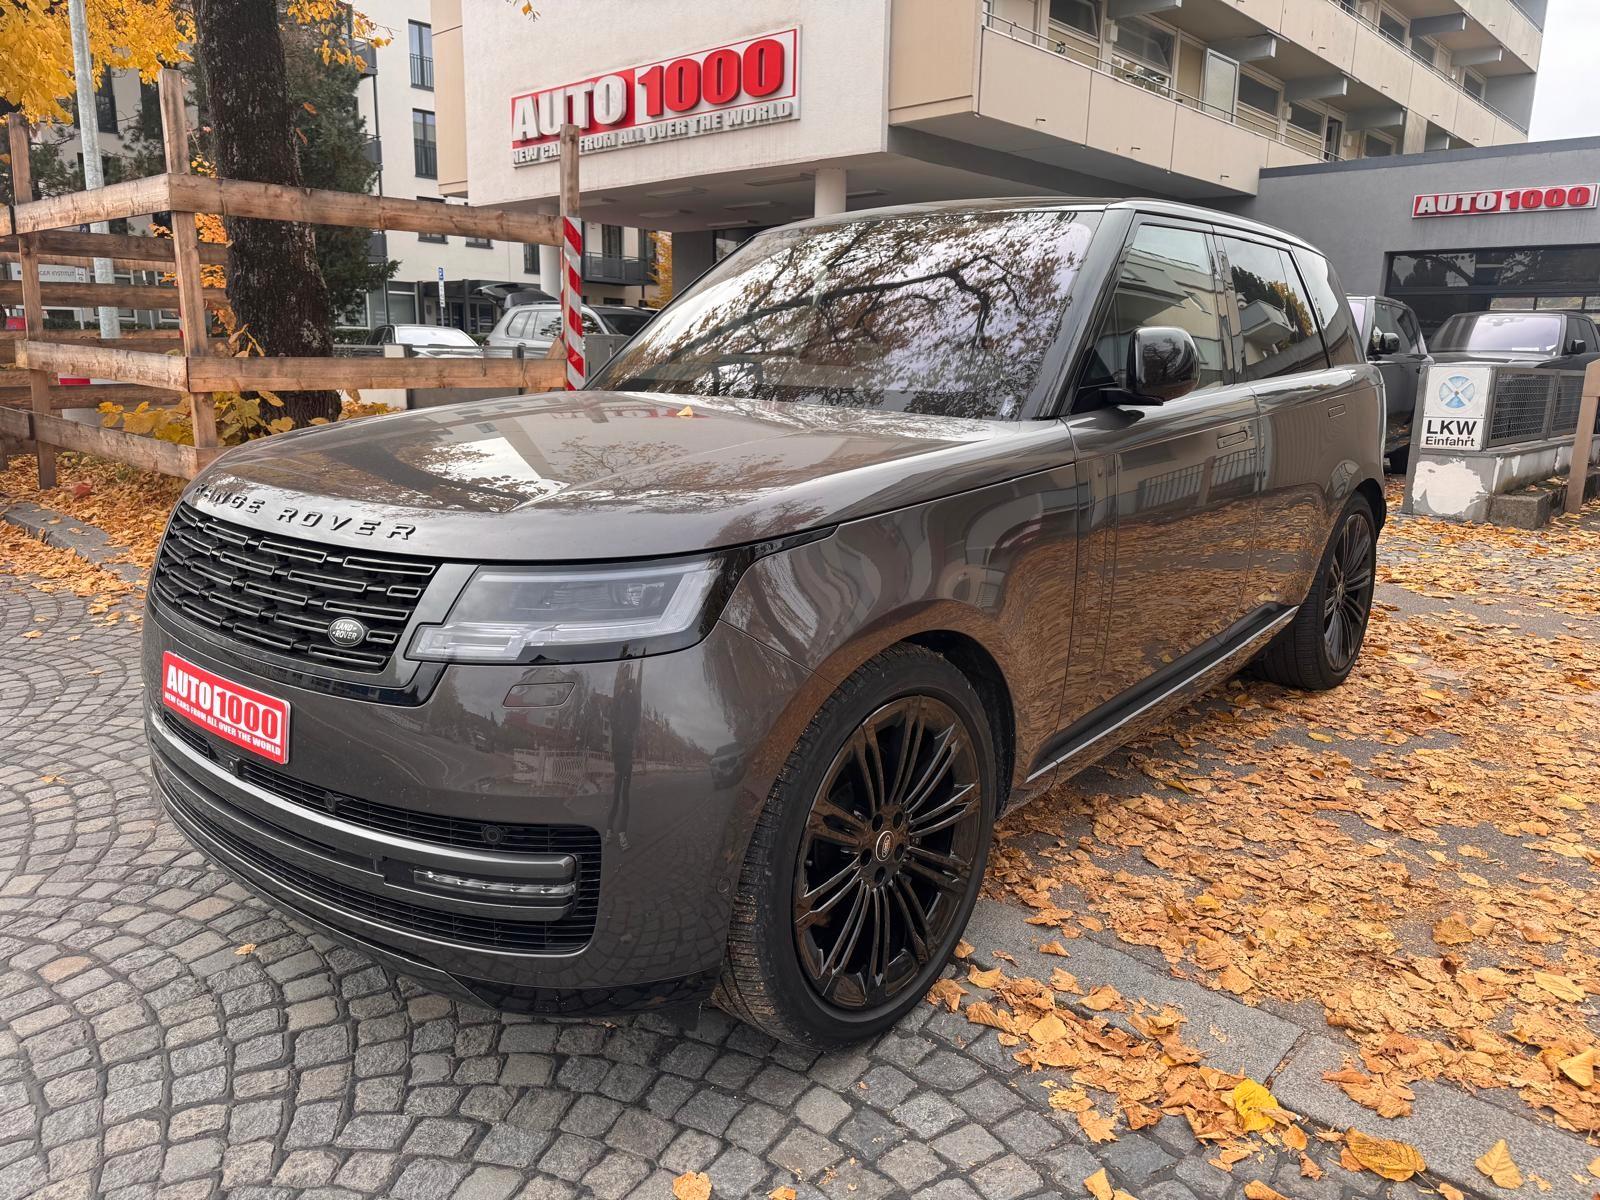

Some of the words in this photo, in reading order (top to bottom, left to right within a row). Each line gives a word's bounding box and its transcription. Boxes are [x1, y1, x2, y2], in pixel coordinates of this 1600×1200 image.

[512, 74, 627, 140] AUTO
[638, 38, 785, 118] 1000
[513, 147, 540, 164] NEW
[579, 132, 618, 152] FROM
[619, 127, 645, 144] ALL
[646, 120, 687, 141] OVER
[687, 113, 723, 133] THE
[724, 101, 794, 127] WORLD
[1416, 192, 1497, 214] AUTO
[1505, 186, 1591, 209] 1000
[1425, 436, 1475, 447] Einfahrt
[1426, 419, 1477, 436] LKW
[277, 507, 417, 540] ROVER
[164, 691, 177, 704] NEW
[176, 698, 190, 713] CARS
[190, 706, 207, 722] FROM
[206, 715, 218, 728] ALL
[218, 721, 237, 737] OVER
[237, 730, 252, 744] THE
[252, 736, 281, 756] WORLD
[166, 664, 212, 710] AUTO
[216, 690, 279, 740] 1000
